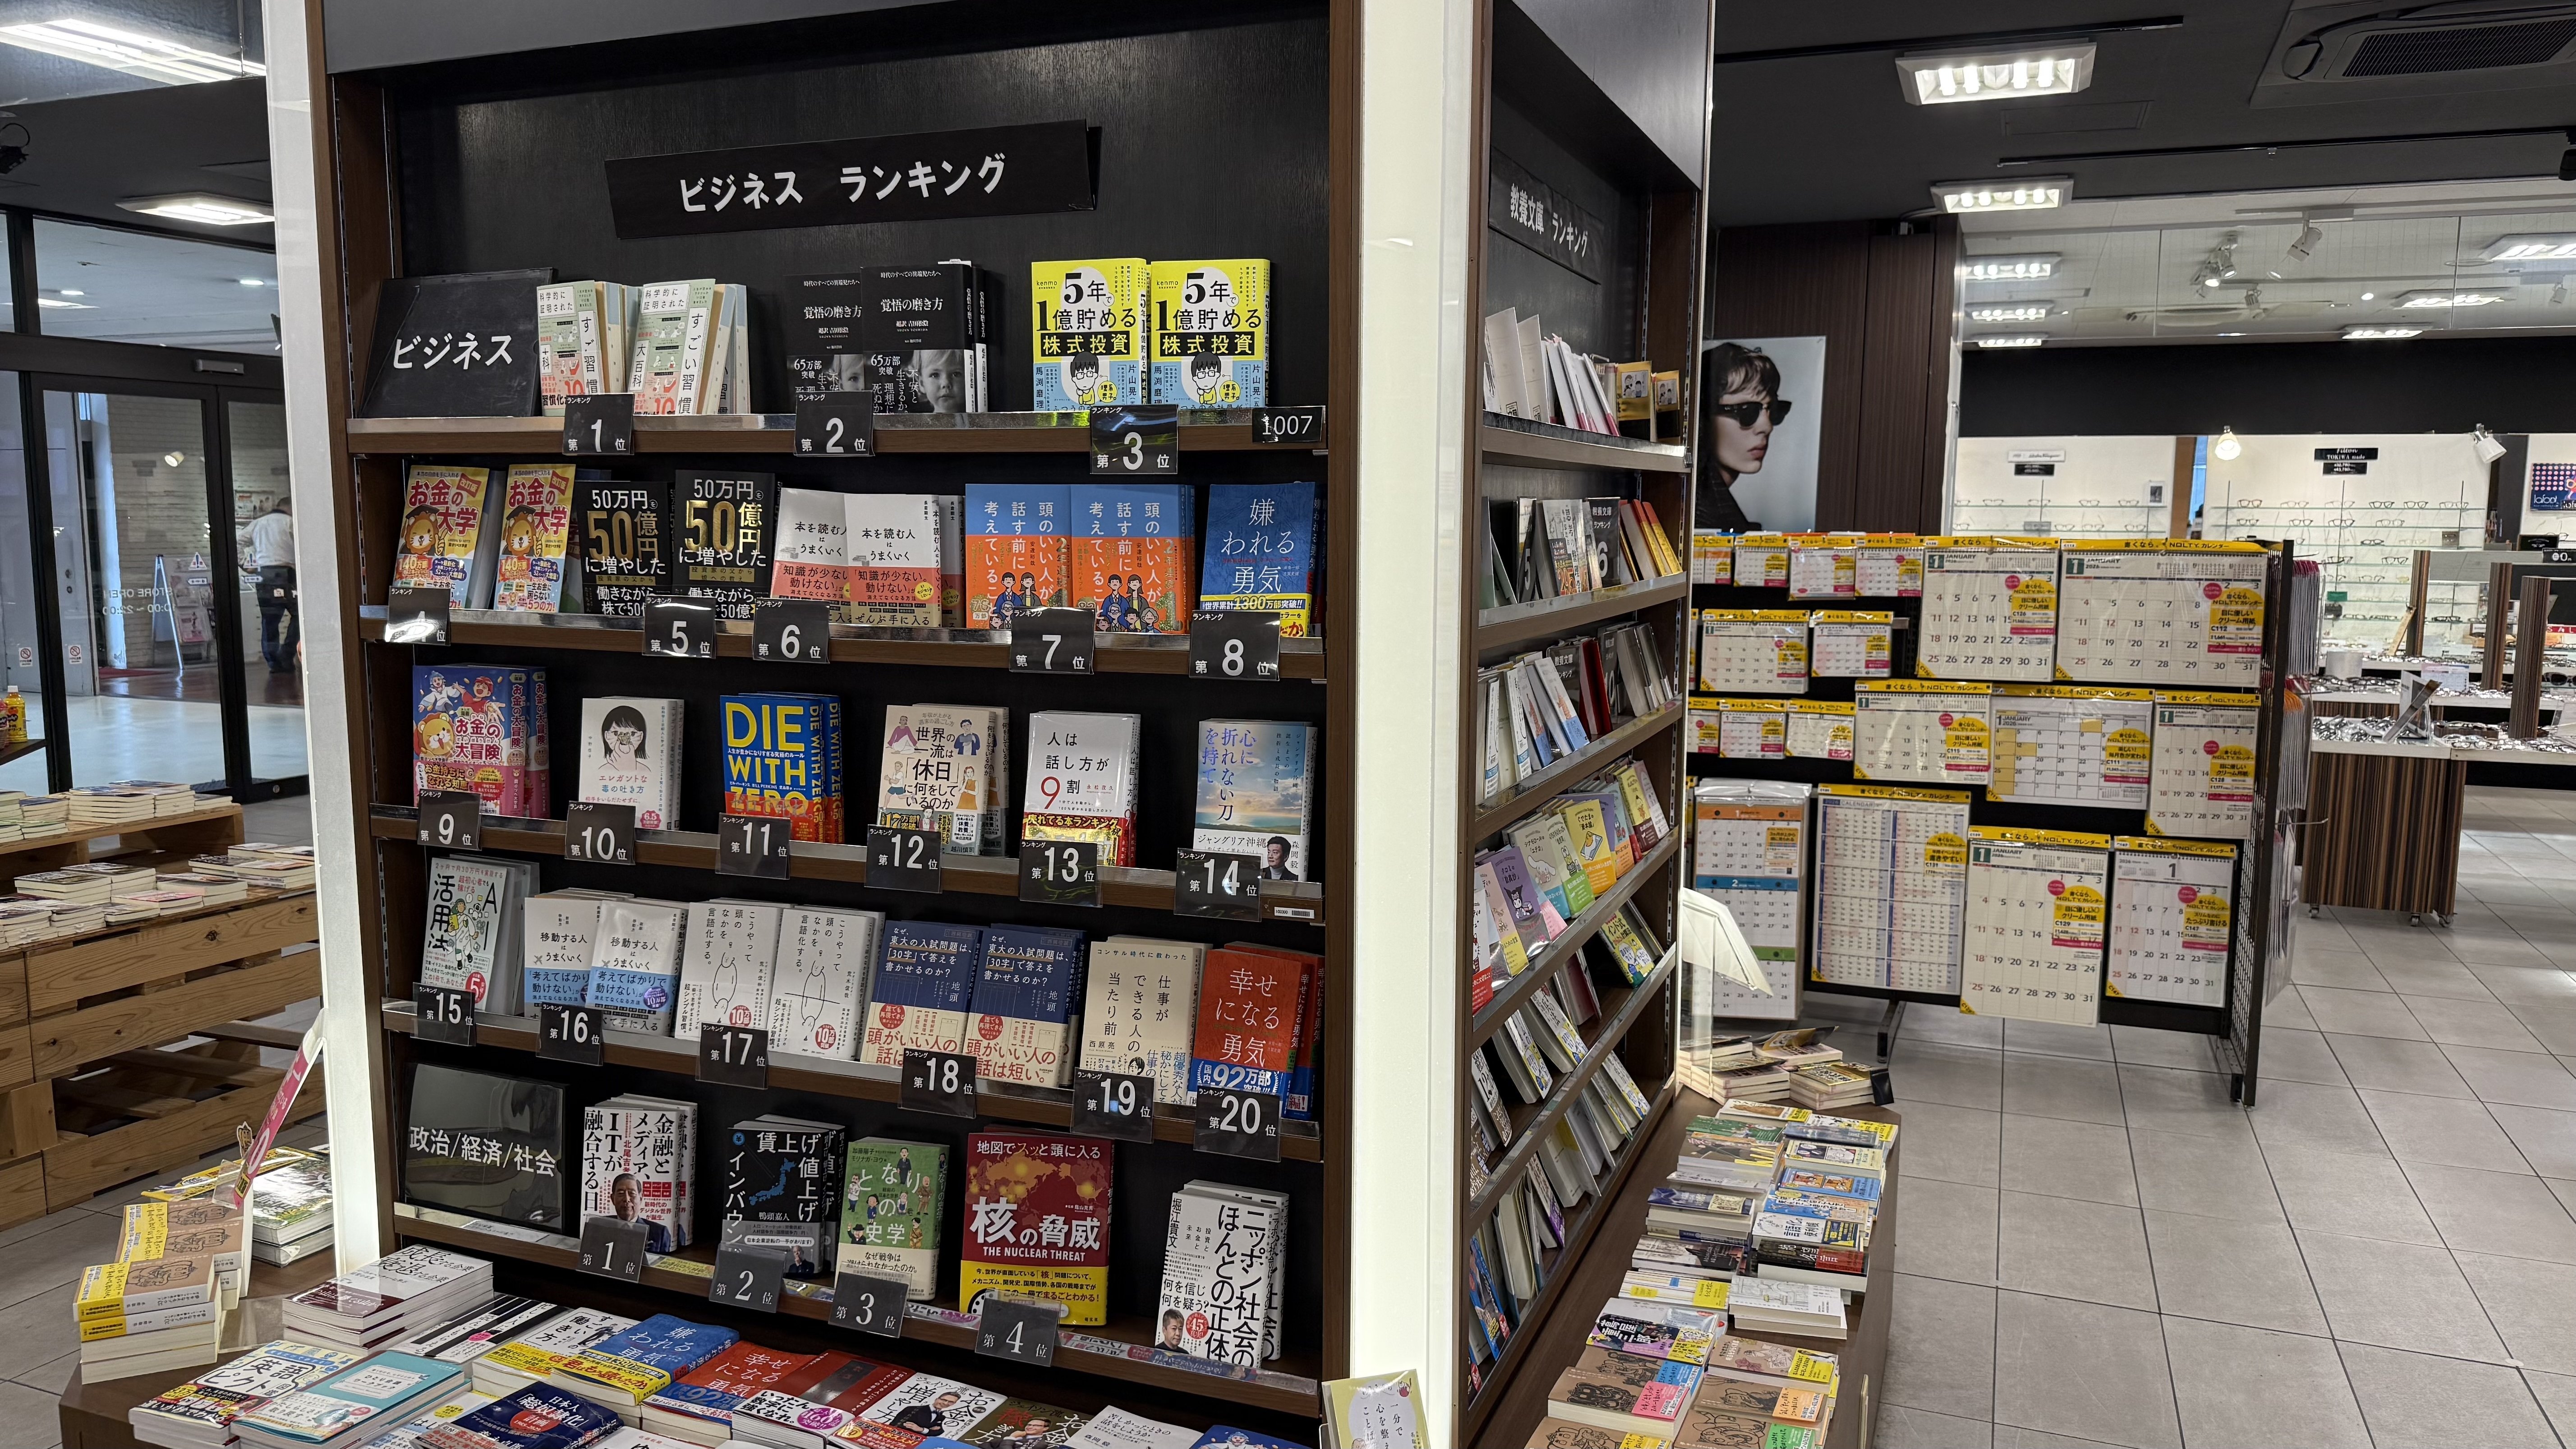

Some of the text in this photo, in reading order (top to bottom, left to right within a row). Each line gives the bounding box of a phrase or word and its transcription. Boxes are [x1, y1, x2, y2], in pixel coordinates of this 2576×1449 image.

[681, 152, 1006, 212] ビジネス ランキング
[1510, 183, 1588, 258] 教養文庫 ランキング
[540, 291, 566, 300] 科学的に
[645, 289, 678, 298] 科学的に
[881, 298, 943, 312] 覚悟の磨き方
[394, 332, 512, 369] ビジネス
[1043, 334, 1128, 354] 株式投資
[1162, 334, 1251, 354] 株式投資
[802, 371, 814, 379] 突破
[879, 367, 893, 375] 突破
[909, 369, 919, 403] 不安と
[2534, 494, 2558, 504] lafont
[1249, 498, 1275, 526] 嫌
[1592, 507, 1612, 516] 教養文庫
[862, 528, 915, 539] 本を読む人
[1221, 531, 1294, 555] われる
[870, 550, 910, 561] うまくいく
[1597, 541, 1608, 577] 6
[1524, 547, 1532, 590] 5
[1232, 566, 1281, 593] 勇気
[527, 591, 550, 600] 困らない
[1928, 655, 1939, 663] 25
[1946, 655, 1957, 664] 26
[2036, 657, 2047, 666] 31
[726, 702, 805, 751] DIE
[918, 718, 954, 727] 週末の過ごし方
[810, 706, 821, 774] DIE WITH
[915, 727, 955, 742] 世界の
[1047, 731, 1077, 746] 人は
[1202, 728, 1219, 784] を持て
[1240, 729, 1257, 764] 心に
[728, 755, 806, 785] WITH
[1046, 755, 1109, 771] 話し方が
[599, 775, 648, 783] エレガントな
[602, 785, 644, 794] 毒の吐き方
[1291, 840, 1300, 869] 森岡毅
[457, 884, 476, 894] 稼げる
[721, 909, 729, 939] なかを
[735, 909, 743, 929] 頭の
[2186, 918, 2227, 927] たっぷり書ける
[540, 932, 587, 944] 移動する人
[812, 917, 821, 947] なかを
[894, 927, 909, 935] なぜ、
[991, 935, 1007, 943] なぜ、
[611, 937, 658, 952] 移動する人
[1229, 968, 1278, 998] 幸せ
[1104, 971, 1120, 1036] 当たり前
[1156, 975, 1171, 1021] 仕事が
[1216, 998, 1279, 1030] になる
[1089, 1040, 1115, 1050] 西原亮
[1203, 1064, 1212, 1085] 国内
[1199, 1089, 1224, 1097] ランキング
[410, 1126, 556, 1177] 政治/経済/社会
[757, 1132, 822, 1154] 賃上げ
[969, 1196, 1101, 1251] 核の脅威
[983, 1247, 1086, 1261] THE NUCLEAR THREAT
[243, 1358, 311, 1380] 英語
[205, 1370, 275, 1394] ピクト
[1390, 1403, 1403, 1436] 一分で
